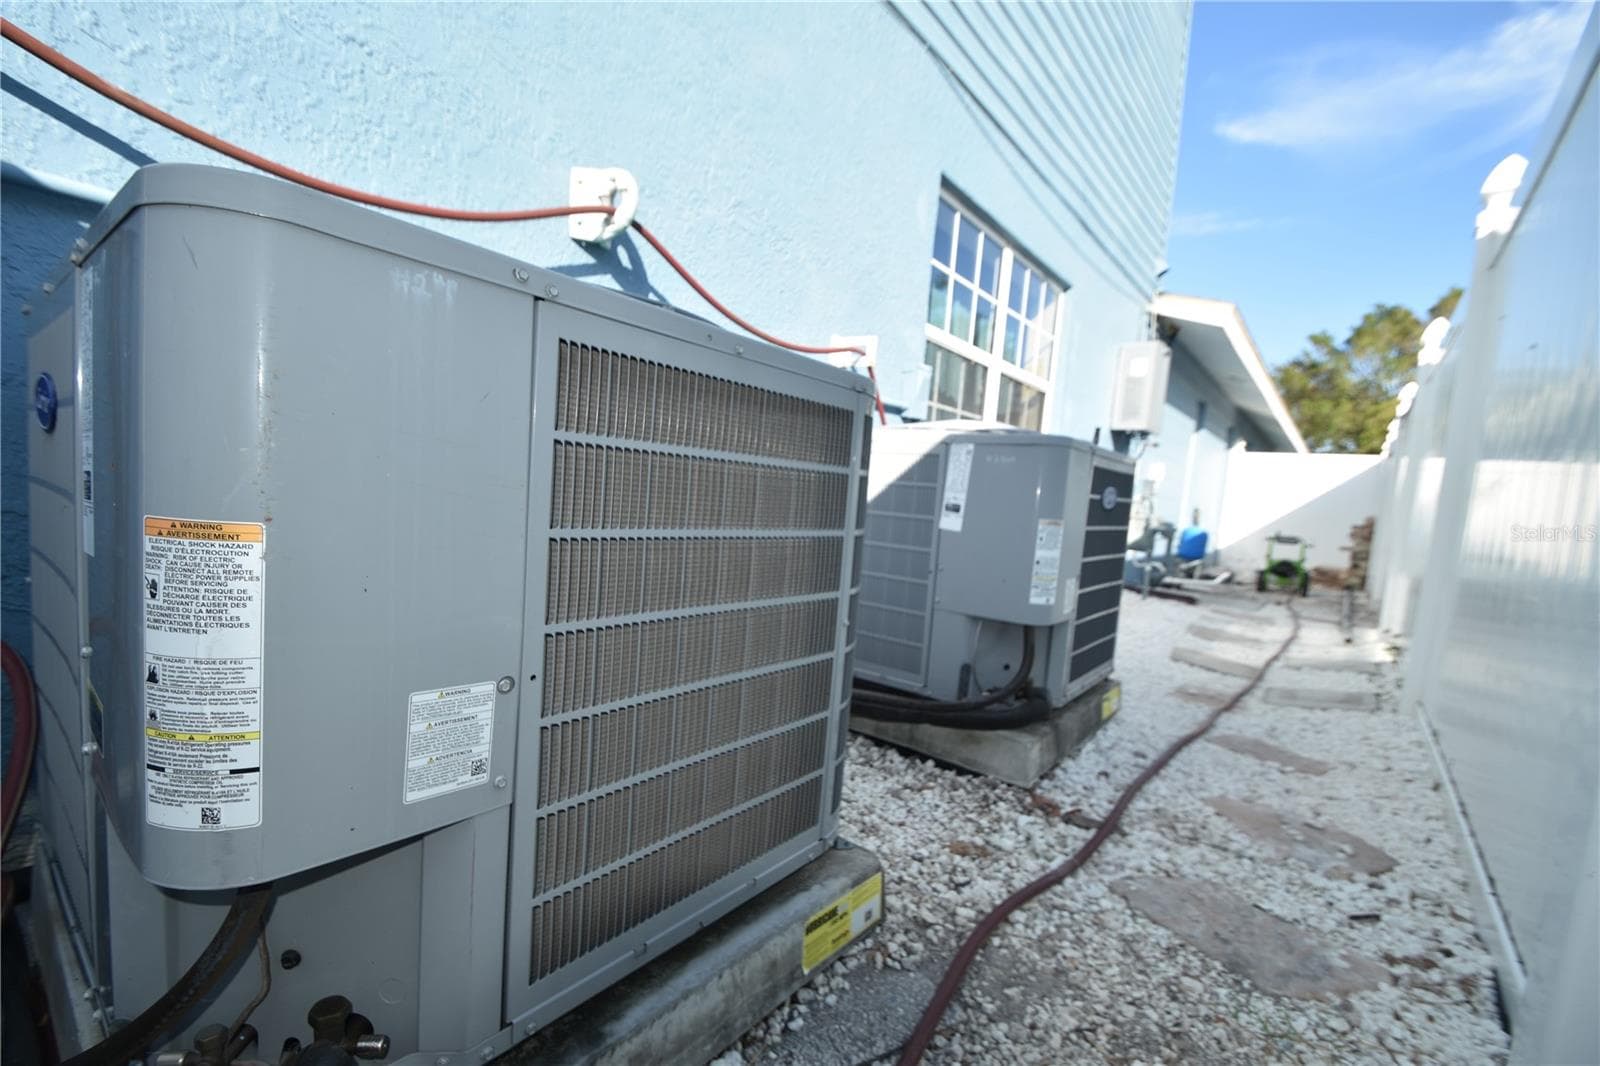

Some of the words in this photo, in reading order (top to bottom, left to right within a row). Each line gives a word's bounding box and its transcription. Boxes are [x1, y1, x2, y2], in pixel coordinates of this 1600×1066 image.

[180, 522, 222, 531] WARNING
[167, 530, 240, 540] AVERTISSEMENT
[149, 538, 186, 547] ELECTRICAL
[218, 542, 254, 550] HAZARD
[151, 545, 172, 553] RISQUE
[175, 547, 250, 557] D'ÉLECTROCUTION
[165, 566, 205, 574] DISCONNECT
[164, 572, 194, 580] ELECTRIC
[164, 578, 188, 586] BEFORE
[190, 580, 228, 588] SERVICING
[146, 604, 180, 613] BLESSURES
[146, 617, 194, 628] ALIMENTATIONS
[164, 626, 208, 634] L'ENTRETIEN
